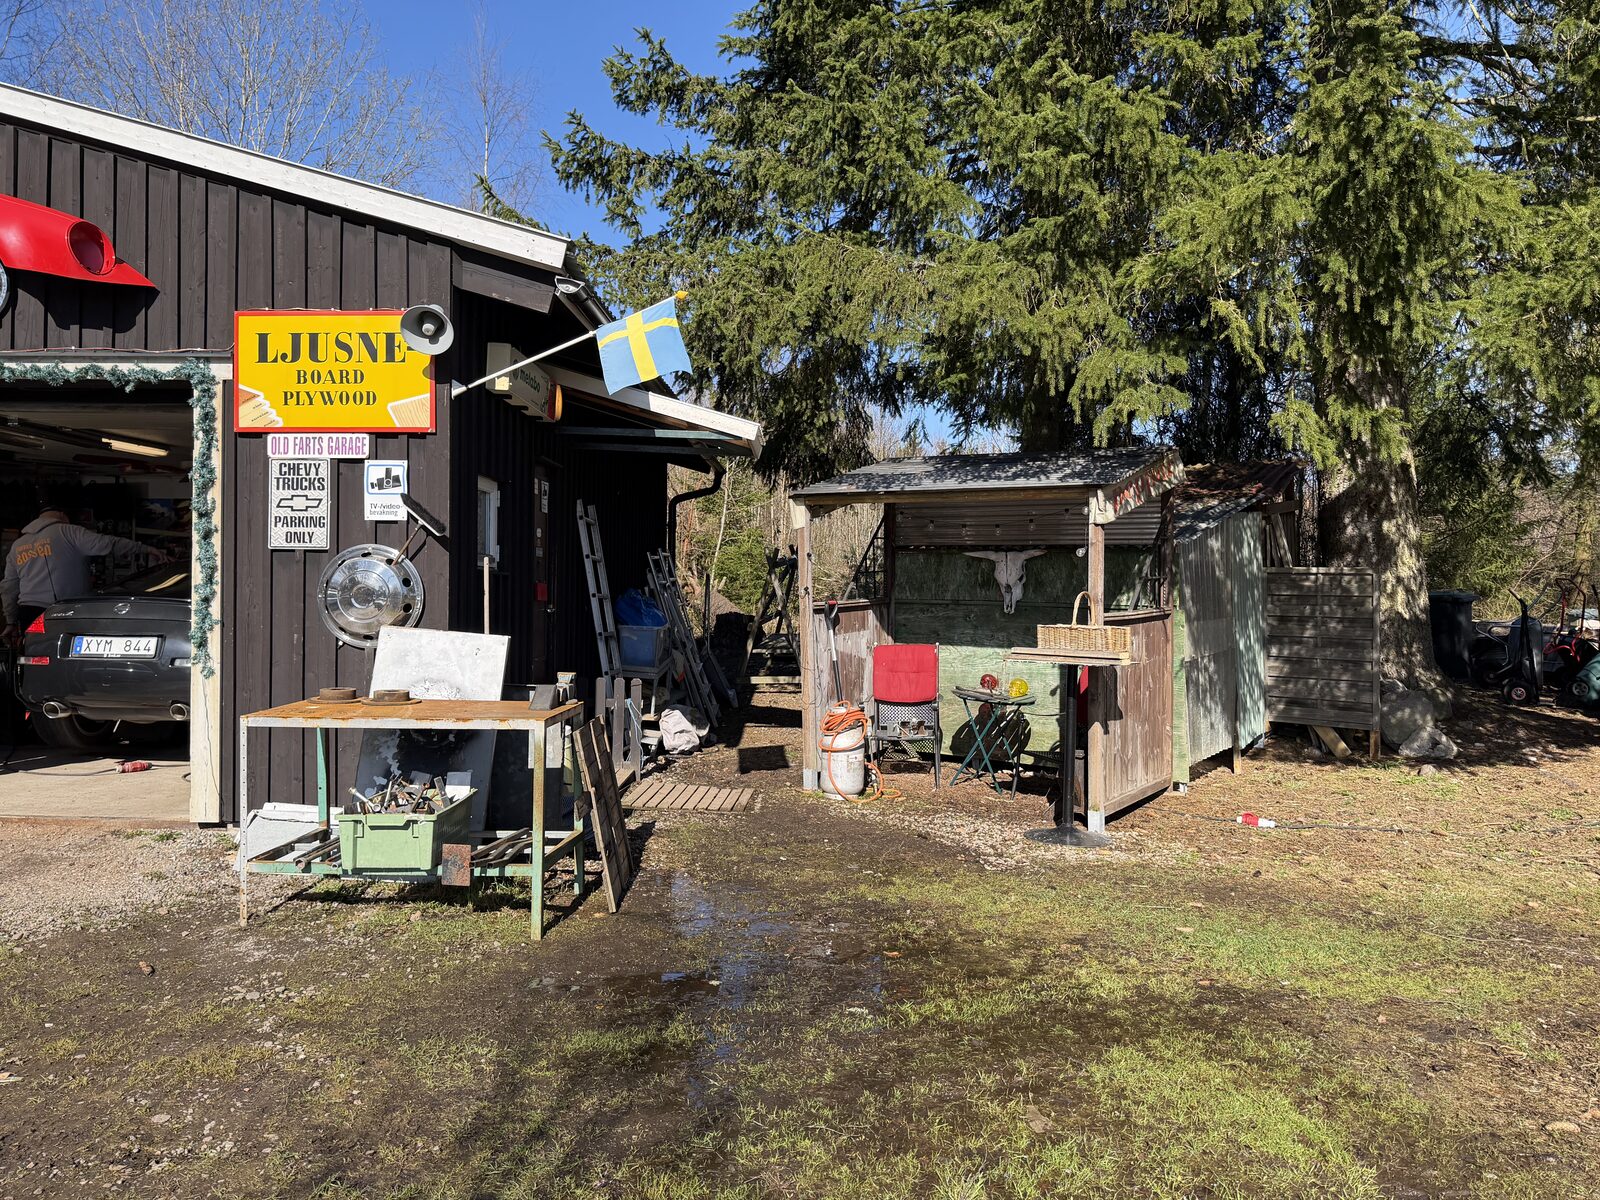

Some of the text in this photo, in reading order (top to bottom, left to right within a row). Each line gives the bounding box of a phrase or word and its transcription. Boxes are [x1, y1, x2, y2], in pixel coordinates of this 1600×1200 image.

[296, 369, 365, 385] BOARD
[520, 369, 540, 393] metabo
[282, 390, 377, 406] PLYWOOD
[271, 436, 367, 456] OLD FARTS GARAGE
[278, 462, 321, 477] CHEVY
[274, 476, 325, 491] TRUCKS
[369, 509, 399, 517] bevakning
[274, 515, 326, 528] PARKING
[285, 531, 315, 544] ONLY
[83, 639, 152, 653] XYM 844
